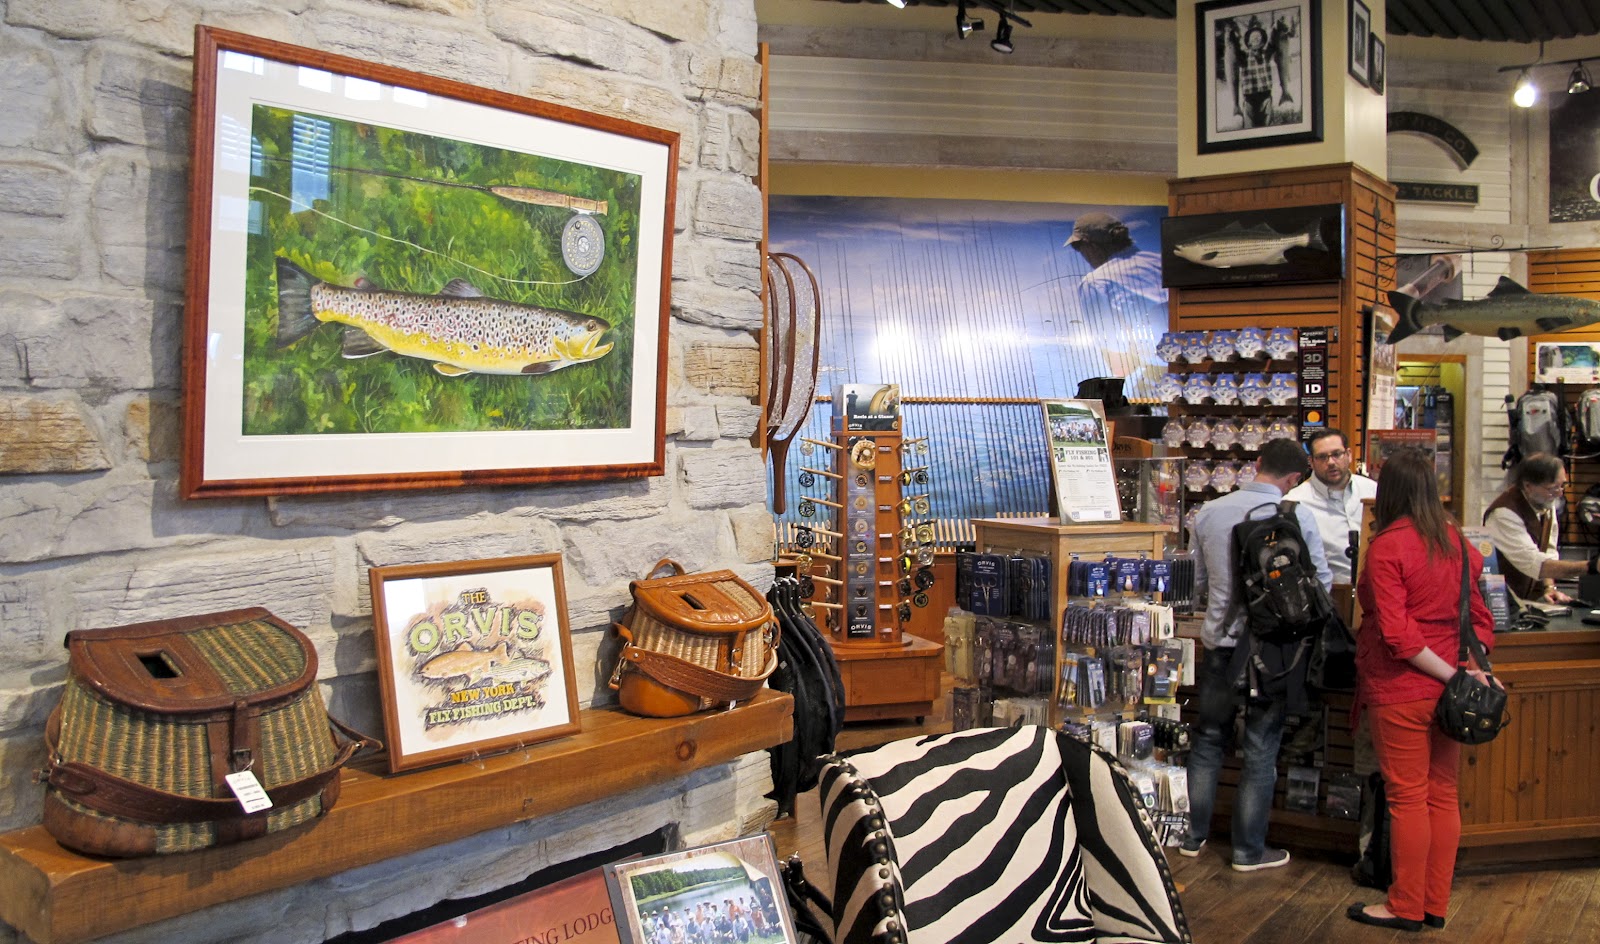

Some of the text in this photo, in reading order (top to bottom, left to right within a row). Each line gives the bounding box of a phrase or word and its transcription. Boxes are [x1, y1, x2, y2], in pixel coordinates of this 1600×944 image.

[1413, 186, 1475, 201] TACKLE
[1303, 354, 1322, 363] 3D
[462, 591, 487, 604] THE
[410, 606, 541, 653] ORVIS
[451, 683, 515, 703] NEW YORK
[430, 695, 536, 724] FLY FISHING DEPT.
[563, 907, 617, 940] LODG
